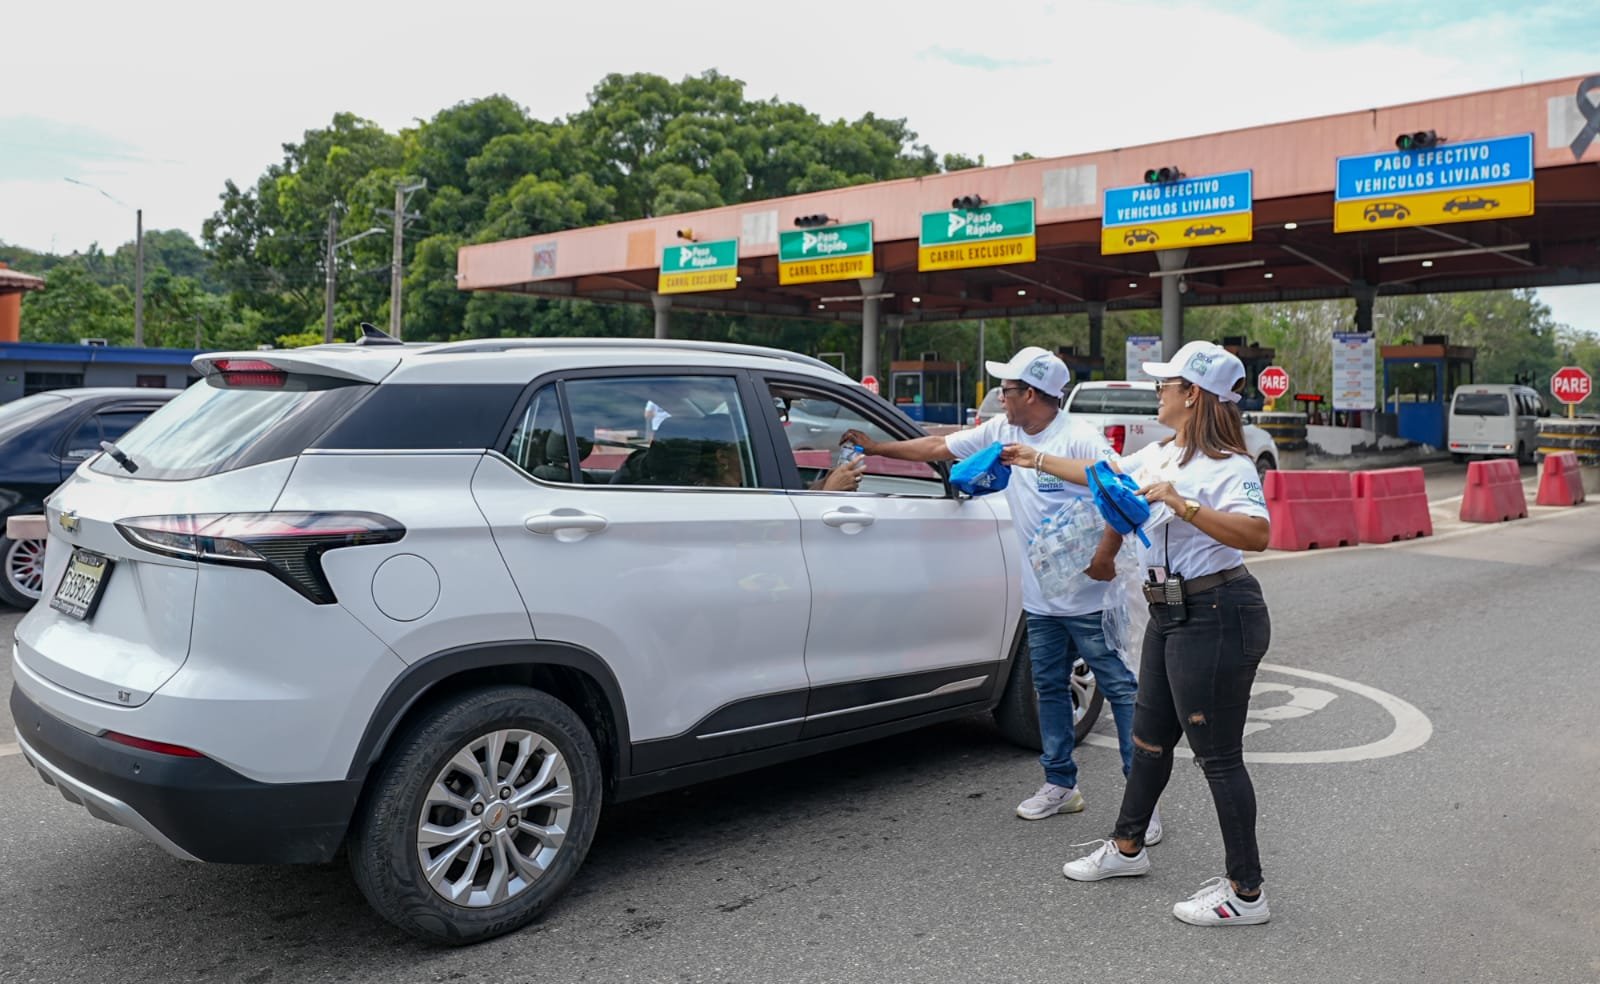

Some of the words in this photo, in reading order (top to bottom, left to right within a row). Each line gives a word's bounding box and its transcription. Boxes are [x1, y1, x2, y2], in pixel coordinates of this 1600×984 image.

[1374, 156, 1411, 172] PAGO
[1417, 145, 1489, 167] EFECTIVO
[1355, 172, 1434, 193] VEHICULOS
[1440, 163, 1511, 184] LIVIANOS
[1132, 187, 1160, 202] PAGO
[1165, 179, 1220, 198] EFECTIVO
[1117, 202, 1178, 221] VEHICULOS
[1182, 195, 1236, 213] LIVIANOS
[966, 212, 992, 224] Paso
[817, 231, 839, 242] Paso
[965, 221, 1004, 237] Rápido
[930, 249, 964, 263] CARRIL
[968, 243, 1023, 260] EXCLUSIVO
[789, 264, 817, 277] CARRIL
[820, 260, 863, 275] EXCLUSIVO
[1261, 375, 1286, 389] PARE
[1554, 377, 1588, 393] PARE
